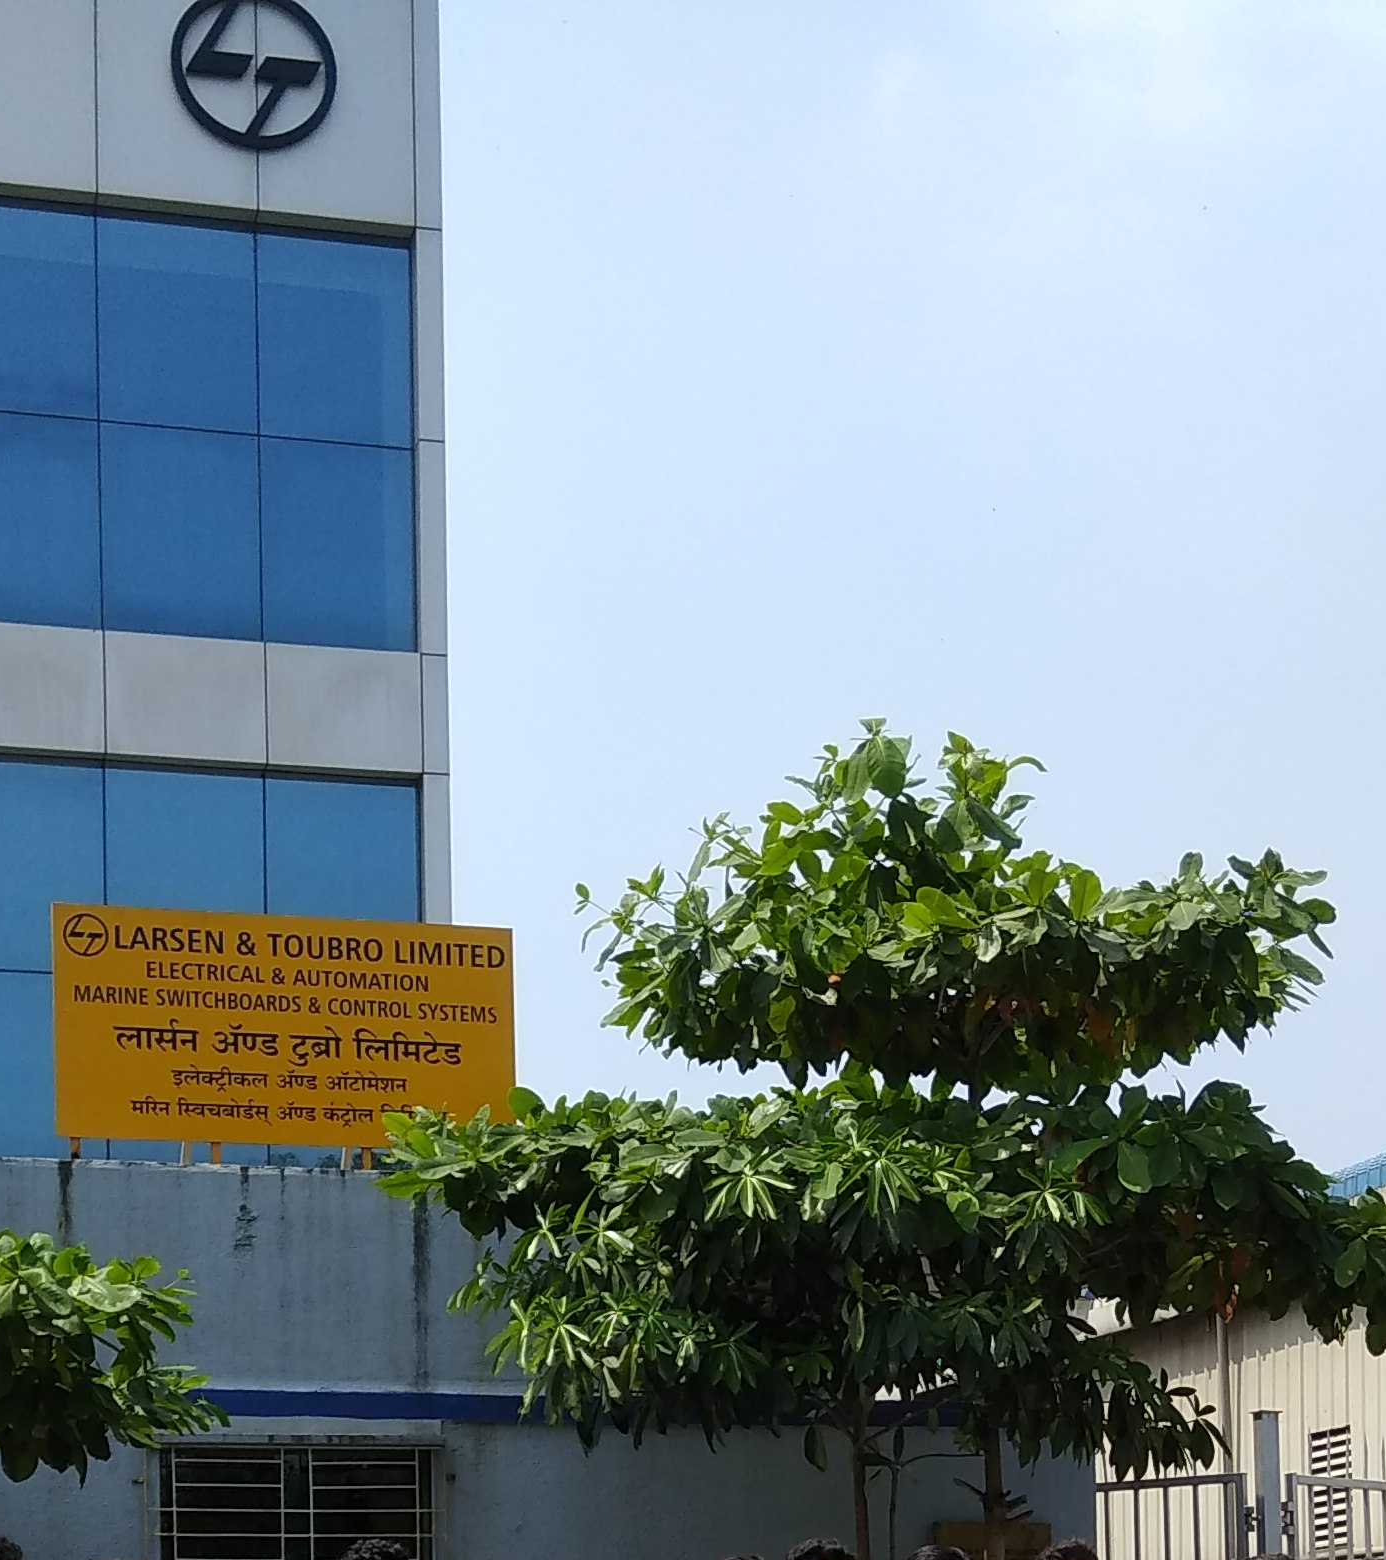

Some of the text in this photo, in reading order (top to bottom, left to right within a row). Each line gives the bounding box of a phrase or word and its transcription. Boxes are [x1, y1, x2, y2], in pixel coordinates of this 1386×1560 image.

[114, 925, 506, 969] LARSEN & TOUBRO LIMITED
[145, 961, 429, 993] ELECTRICAL & AUTOMATION
[73, 985, 498, 1024] MARINE SWITCHBOARDS & CONTROL SYSTEMS
[113, 1018, 200, 1053] लार्सन
[288, 1026, 343, 1067] टुब्रो
[351, 1028, 463, 1065] लिमिटेड
[130, 1096, 170, 1117] मरिन
[321, 1101, 374, 1128] कंट्रोल
